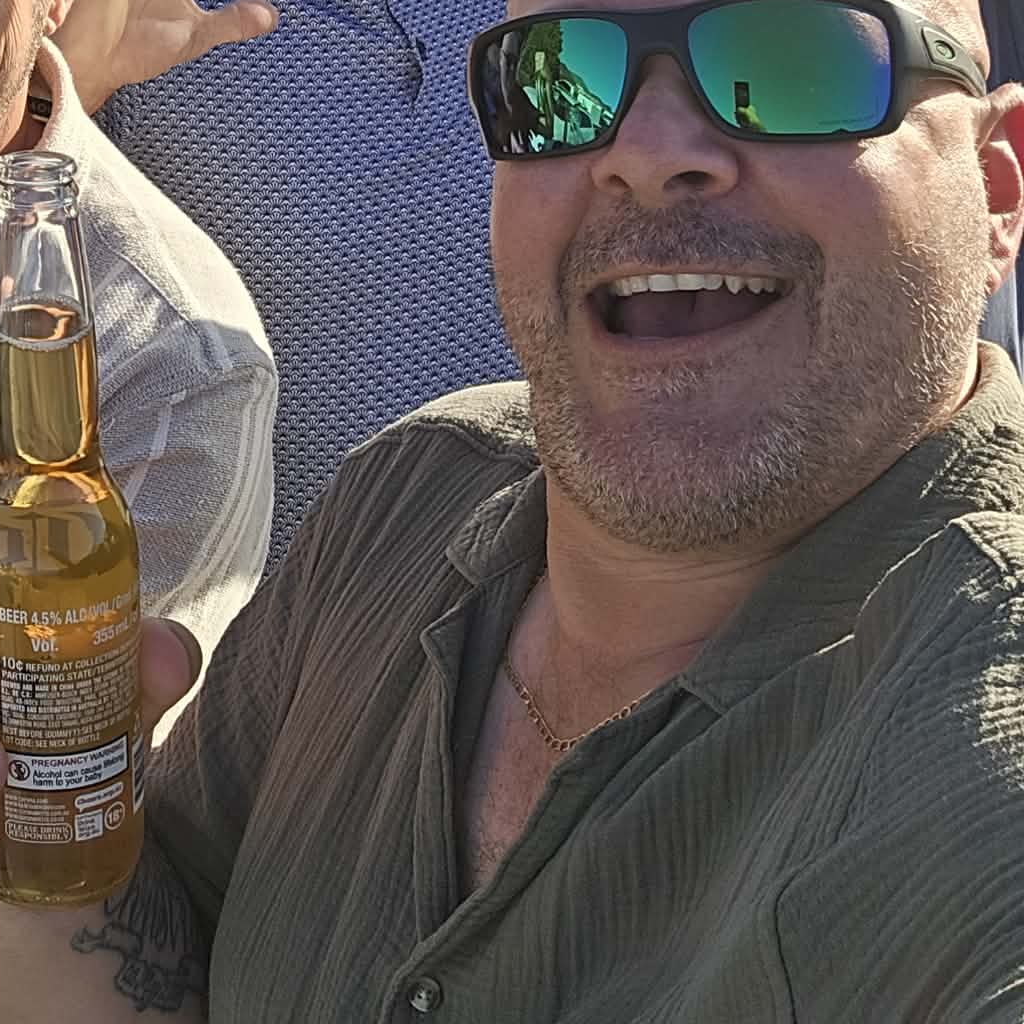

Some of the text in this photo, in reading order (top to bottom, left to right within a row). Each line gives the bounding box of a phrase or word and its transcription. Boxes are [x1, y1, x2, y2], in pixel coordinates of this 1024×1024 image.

[0, 607, 28, 624] BEER
[31, 611, 62, 625] 4.5%
[31, 638, 59, 652] Vol.
[25, 662, 61, 673] REFUND
[62, 661, 73, 671] AT
[1, 670, 65, 682] PARTICIPATING
[31, 754, 88, 768] PREGNANCY
[33, 768, 62, 779] Alcohol
[64, 769, 78, 778] can
[32, 777, 54, 787] harm
[56, 777, 64, 786] to
[65, 776, 83, 788] your
